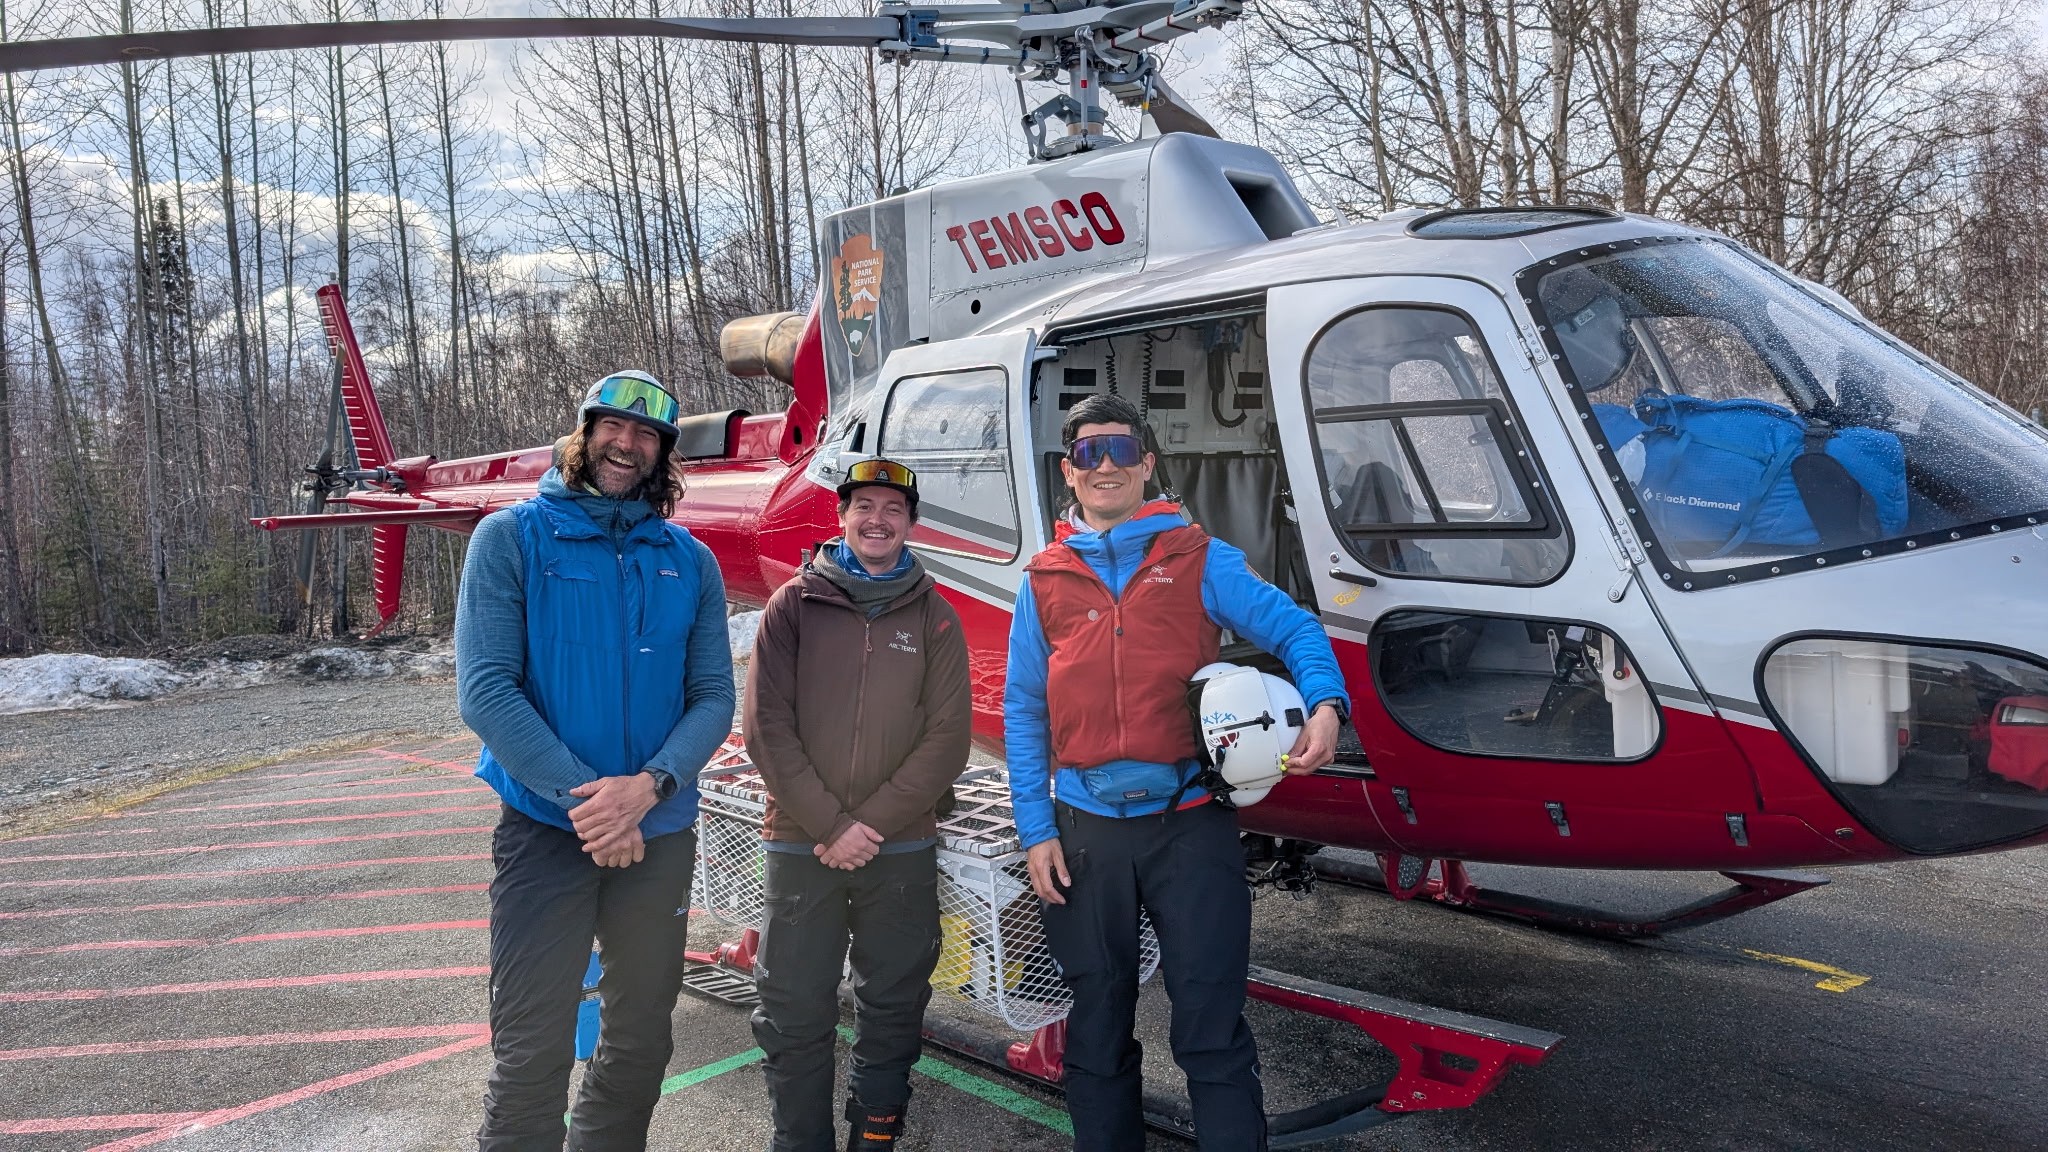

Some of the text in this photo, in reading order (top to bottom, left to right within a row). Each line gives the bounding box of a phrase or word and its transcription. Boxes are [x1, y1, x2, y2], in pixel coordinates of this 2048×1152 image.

[946, 191, 1126, 273] TEMSCO
[851, 257, 880, 270] NATIONAL
[857, 267, 873, 278] PARK
[854, 275, 877, 287] SERVICE
[1688, 496, 1741, 511] Diamond
